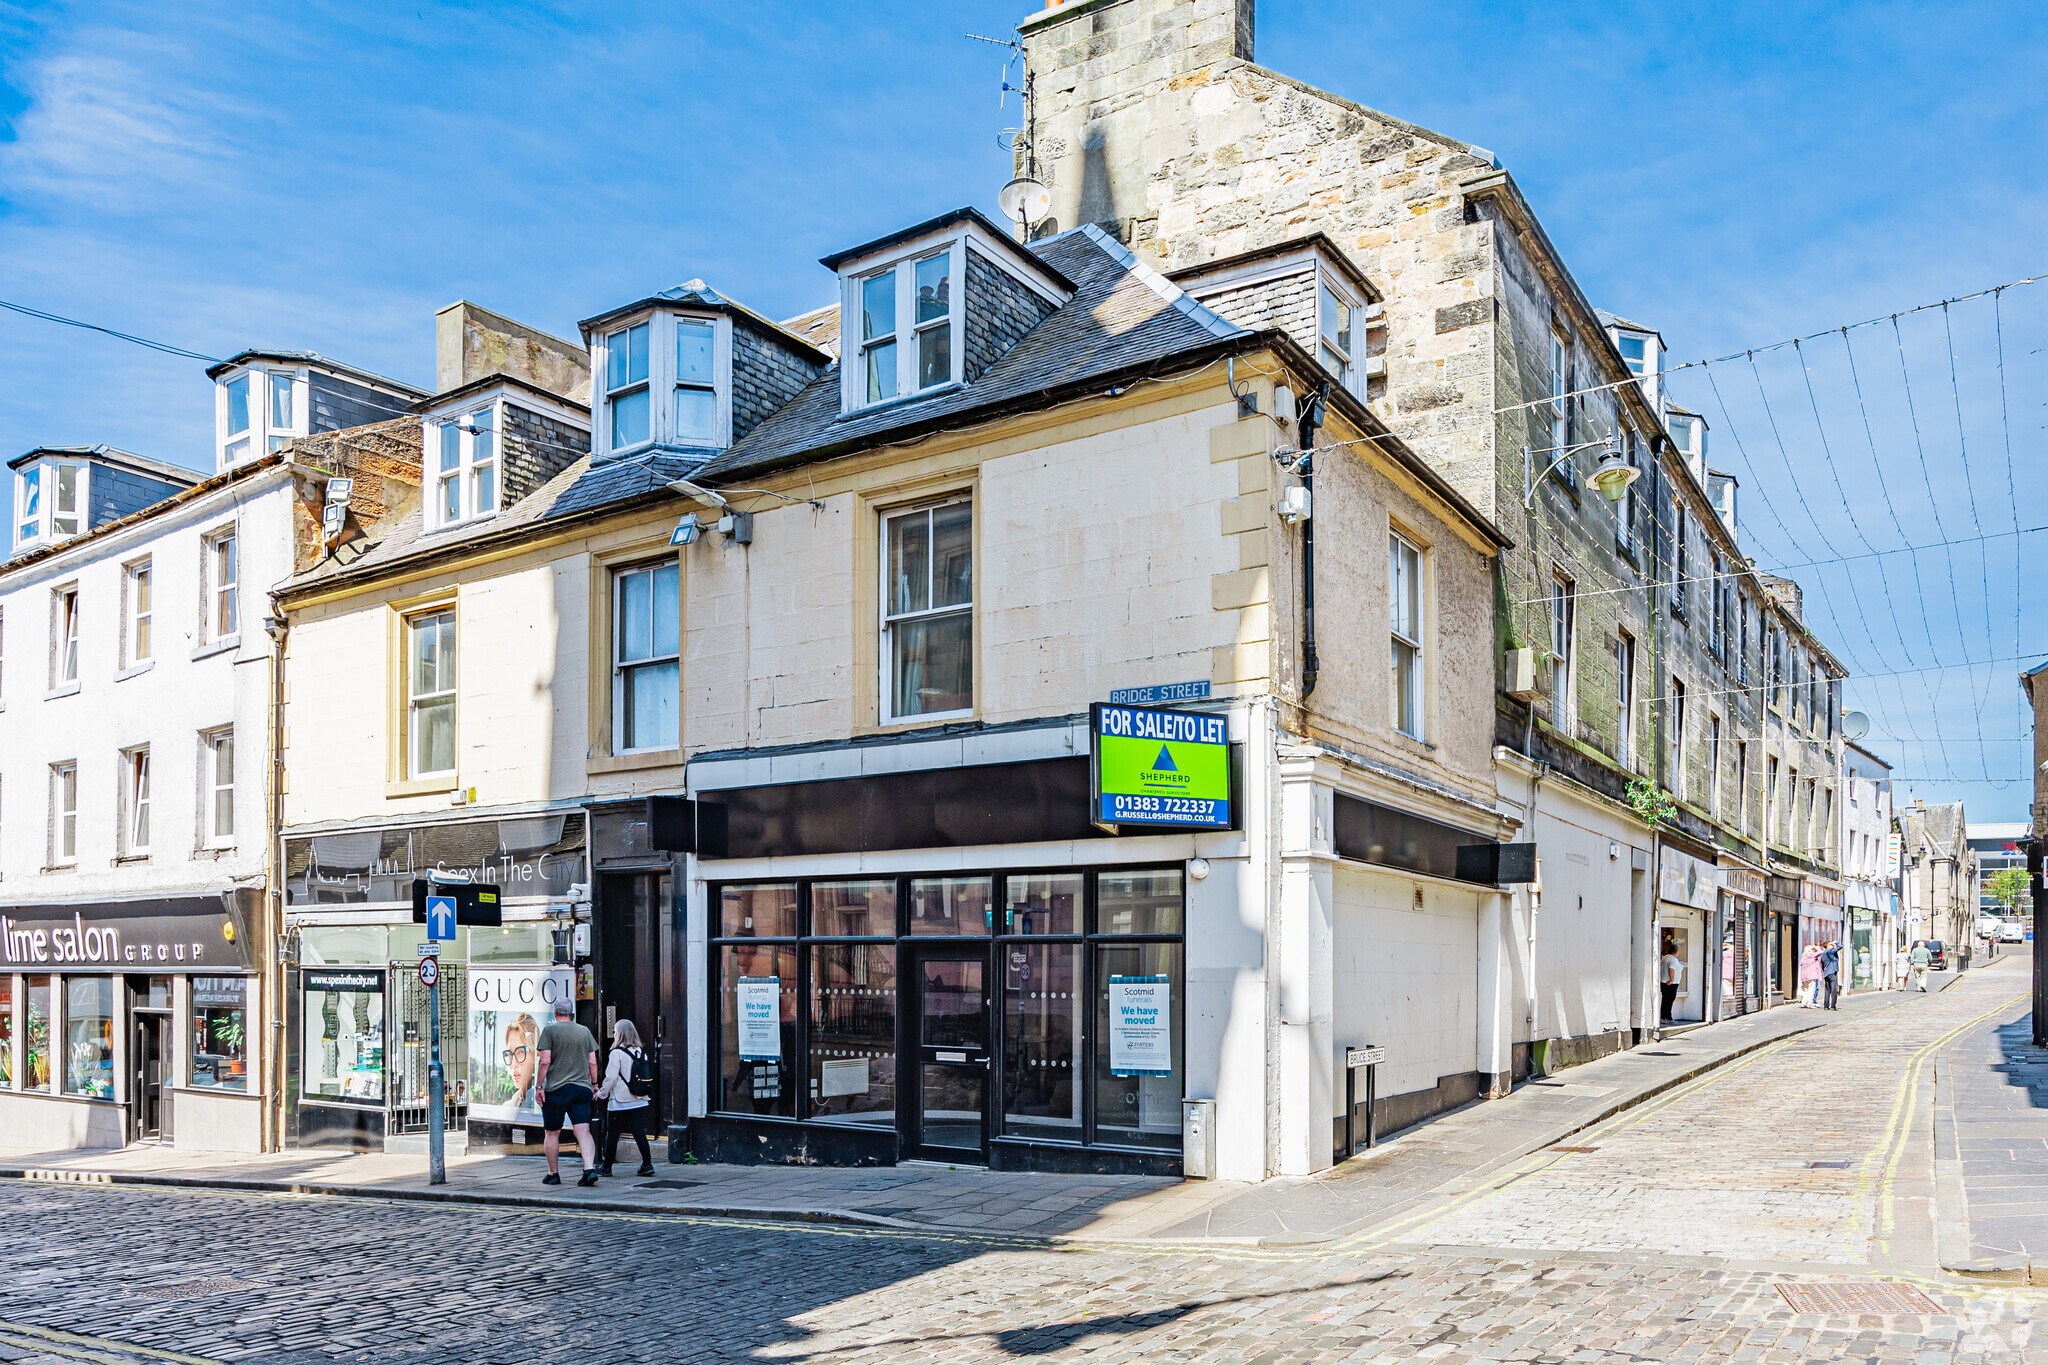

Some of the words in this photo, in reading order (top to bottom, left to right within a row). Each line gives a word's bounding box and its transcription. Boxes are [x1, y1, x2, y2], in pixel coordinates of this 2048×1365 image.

[1112, 688, 1154, 703] BRIDGE
[1160, 682, 1208, 699] STREET
[1101, 707, 1132, 736] FOR
[1135, 711, 1197, 742] SALE/TO
[1200, 717, 1225, 744] LET
[1140, 772, 1191, 783] SHEPHERD
[1115, 796, 1160, 811] 01383
[1163, 798, 1215, 814] 722337
[1115, 811, 1216, 823] G.RUSSELL@SHEPHERD.CO.UK
[437, 861, 479, 884] Sex
[482, 857, 496, 884] In
[499, 855, 533, 883] The
[1, 914, 49, 963] lime
[52, 911, 120, 963] salon
[123, 943, 204, 963] GROUP
[422, 965, 436, 978] 20
[310, 974, 378, 987] www.spexinthecity.net
[474, 977, 570, 1004] GUCCI
[747, 986, 769, 994] Scotmid
[1124, 987, 1155, 996] Scotmid
[745, 1002, 756, 1010] We
[756, 1002, 772, 1010] have
[1120, 1006, 1135, 1015] We
[1137, 1006, 1159, 1015] have
[1124, 1016, 1156, 1025] moved
[1350, 1052, 1366, 1065] BRUCE
[1367, 1049, 1384, 1062] STREET
